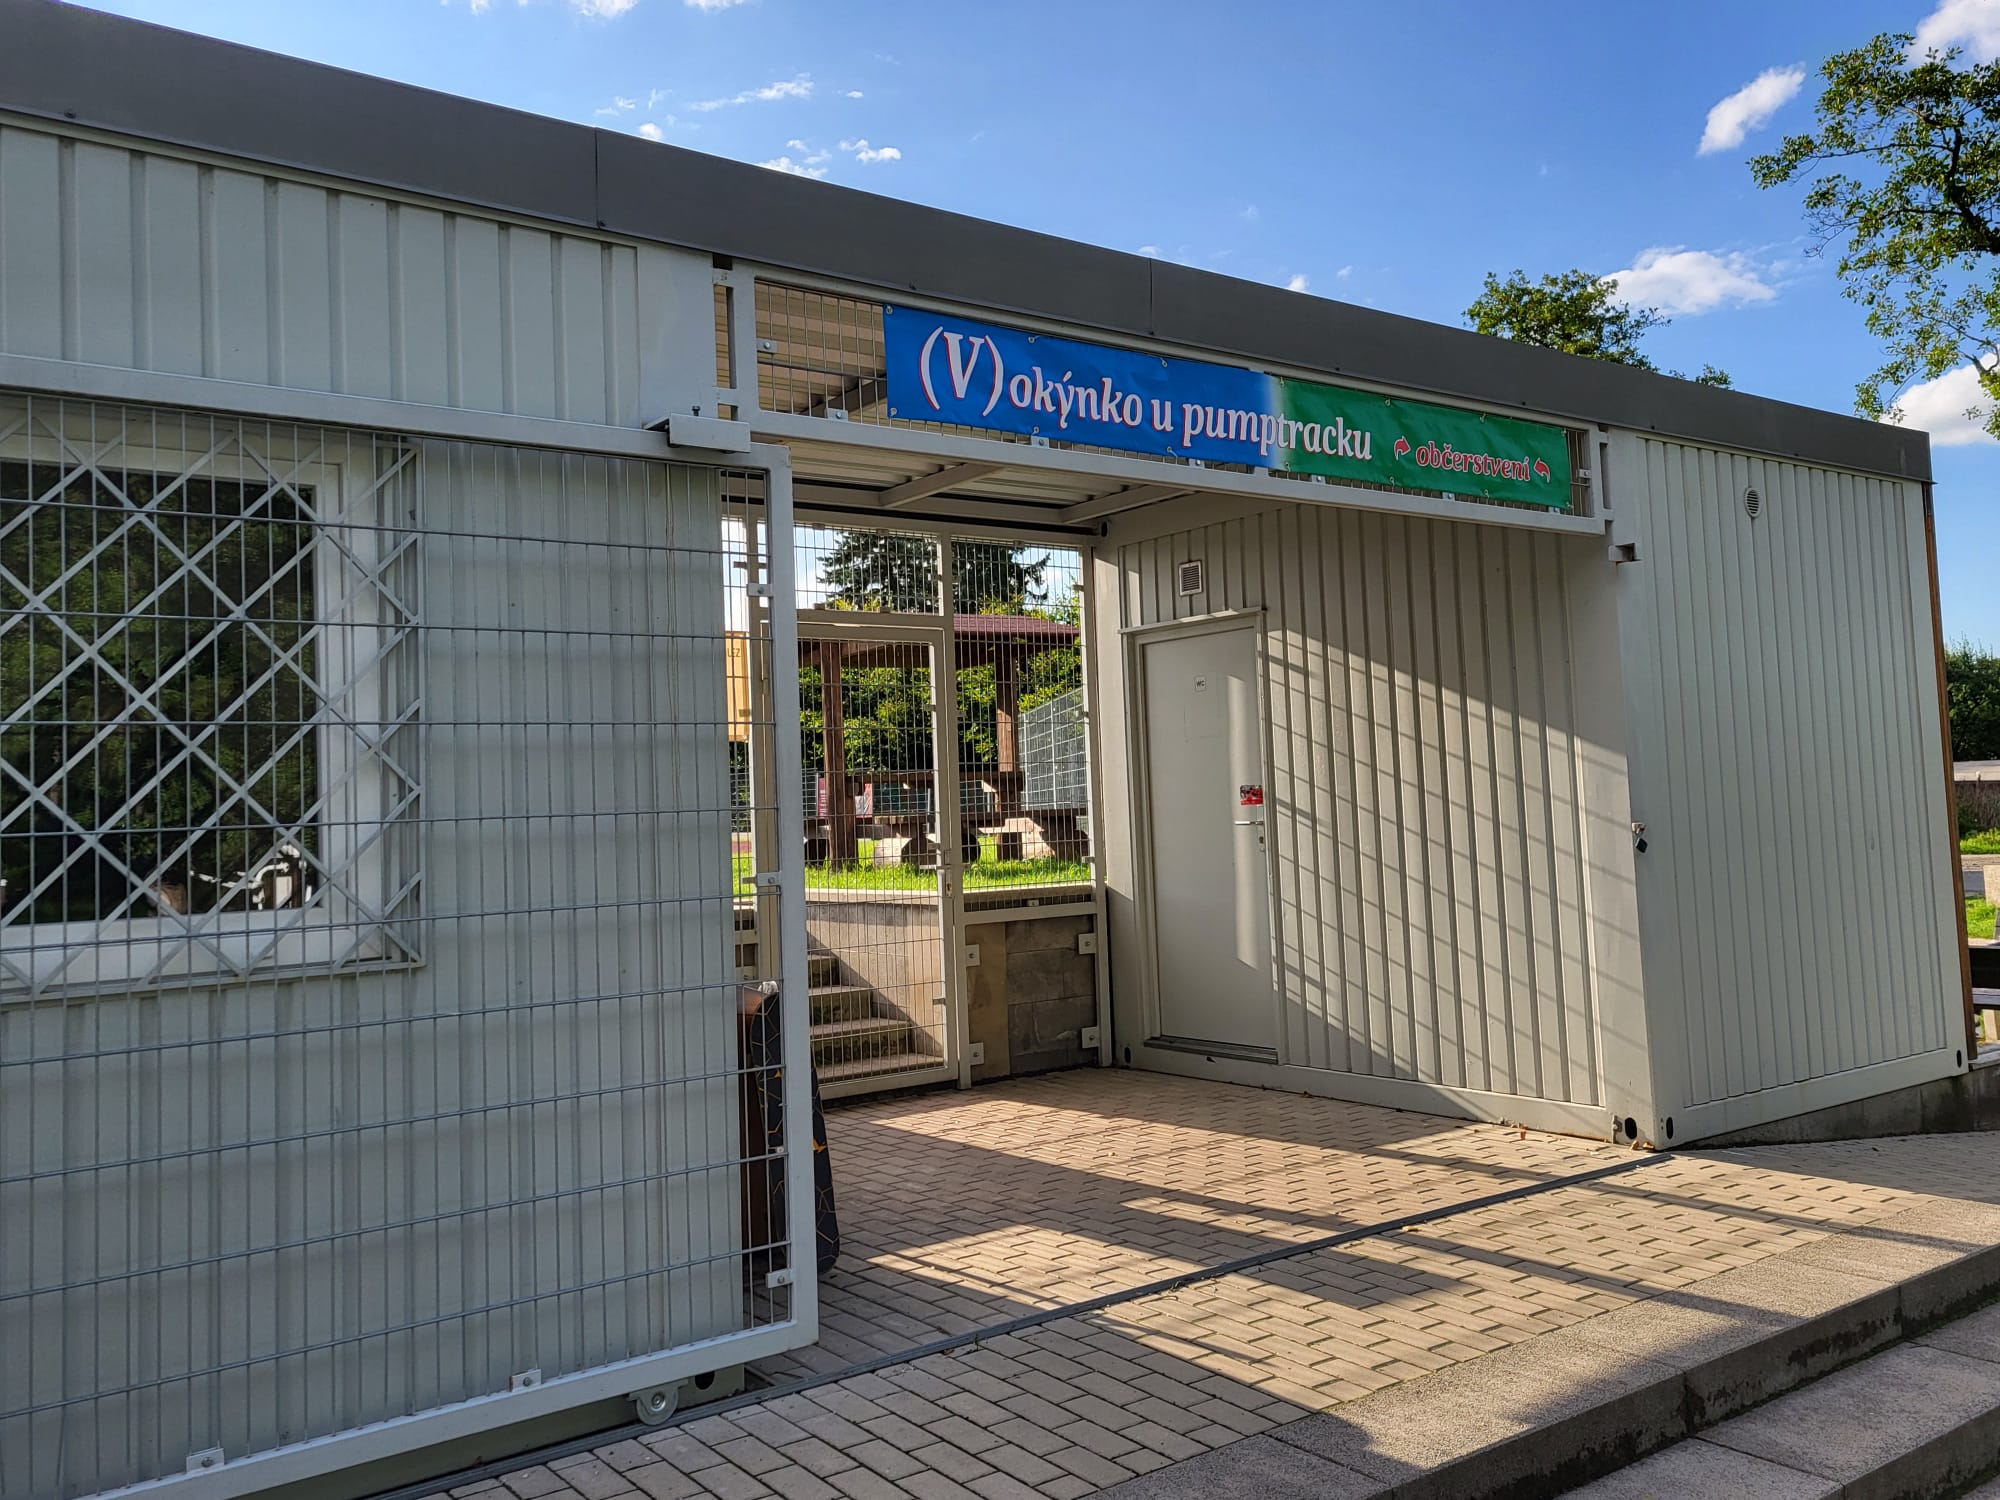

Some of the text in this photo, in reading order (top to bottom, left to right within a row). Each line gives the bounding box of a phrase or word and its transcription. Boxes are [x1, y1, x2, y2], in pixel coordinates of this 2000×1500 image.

[1151, 398, 1174, 432] u
[1182, 402, 1373, 461] pumptracku
[1415, 440, 1531, 482] občerstvení
